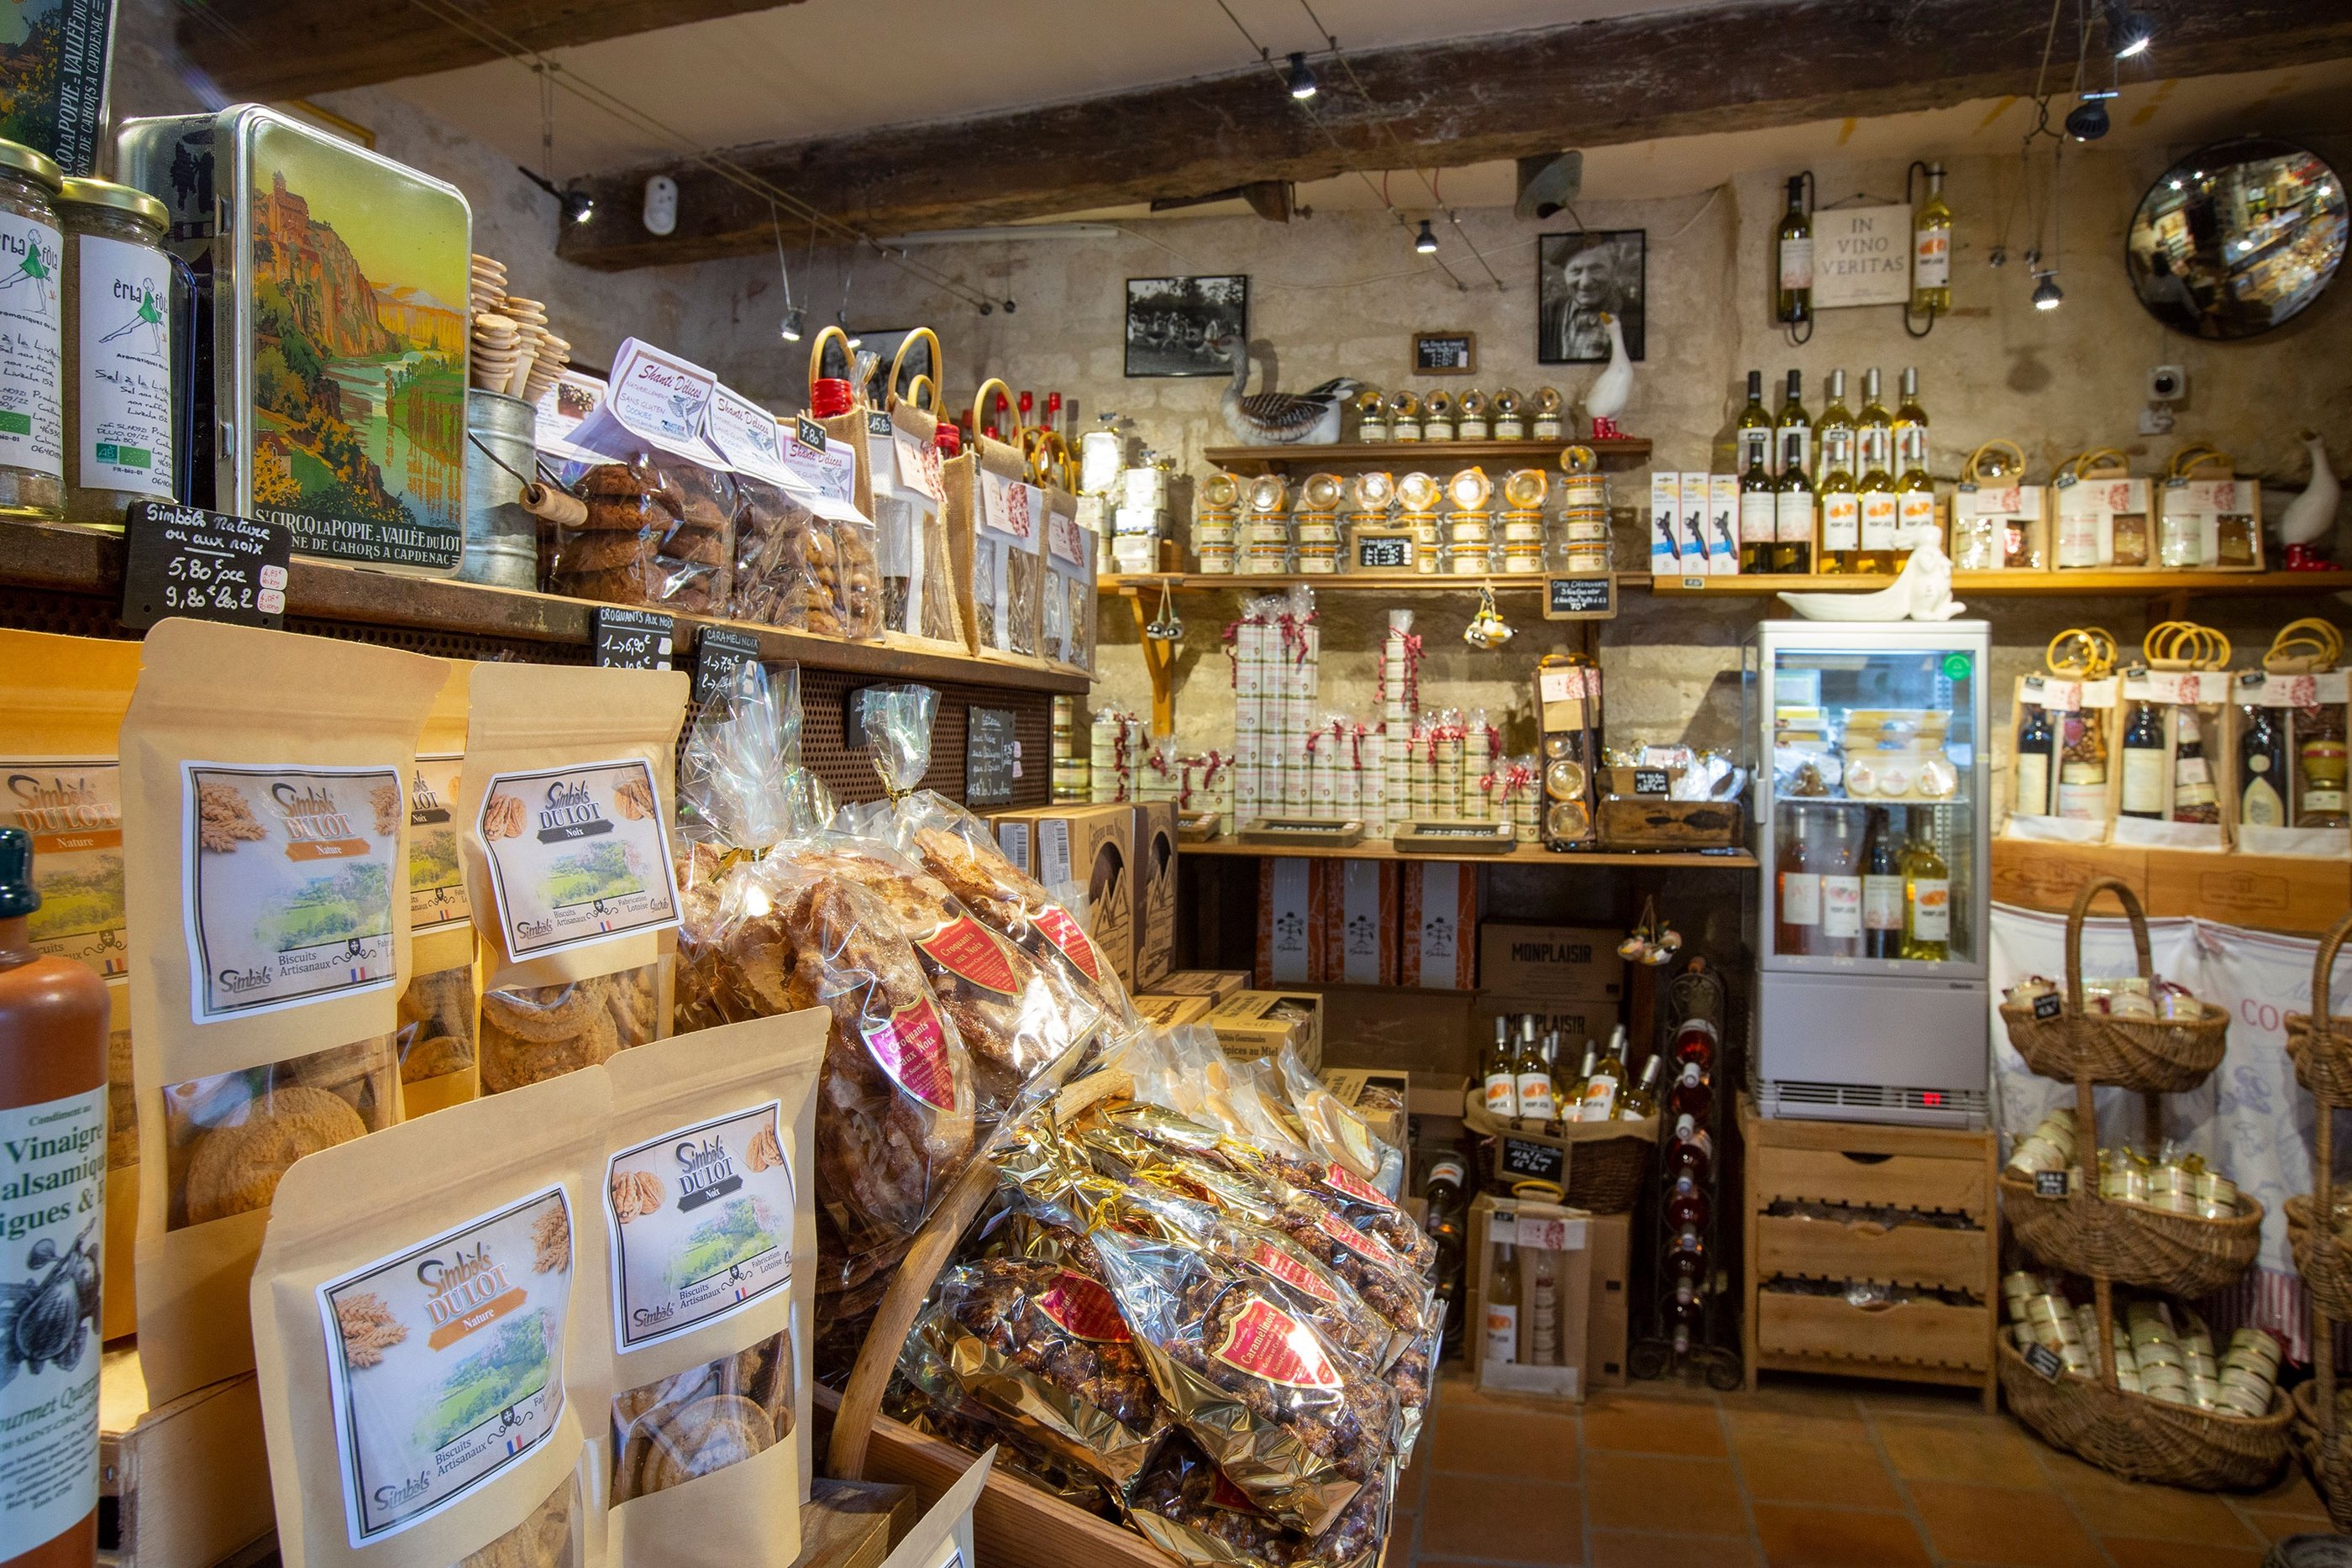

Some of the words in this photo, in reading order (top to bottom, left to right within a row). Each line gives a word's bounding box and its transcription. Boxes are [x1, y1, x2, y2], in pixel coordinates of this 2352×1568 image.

[87, 12, 105, 75] CAPDENAC
[81, 85, 99, 134] CAHORS
[1851, 217, 1872, 233] IN
[0, 233, 26, 256] rba
[1837, 237, 1888, 254] VINO
[1821, 255, 1905, 275] VERITAS
[0, 310, 43, 327] romatiques
[165, 529, 187, 542] ou
[192, 533, 225, 548] aux
[329, 519, 375, 543] POPIE
[381, 526, 427, 548] VALLÉE
[440, 534, 462, 553] LOT
[312, 538, 329, 552] DE
[332, 539, 381, 559] CAHORS
[393, 548, 450, 566] CAPDENAC
[600, 608, 643, 624] CROQUANTS
[16, 806, 62, 833] DU
[64, 803, 116, 831] LOT
[283, 817, 312, 840] DU
[312, 812, 355, 839] LOT
[538, 808, 567, 830] DU
[566, 802, 602, 825] LOT
[57, 836, 94, 849] Nature
[565, 827, 585, 838] Noix
[315, 843, 344, 856] Nature
[553, 909, 577, 919] Biscuits
[556, 914, 587, 928] Artisanaux
[940, 931, 975, 957] Croquants
[953, 952, 968, 965] aux
[964, 941, 984, 957] Noix
[1512, 943, 1593, 964] MONPLAISIR
[277, 951, 318, 967] Biscuits
[279, 960, 331, 978] Artisanaux
[887, 1020, 929, 1054] Croquants
[900, 1050, 917, 1067] aux
[915, 1035, 937, 1053] Noix
[1249, 1047, 1259, 1056] au
[1260, 1046, 1278, 1057] Miel
[4, 1123, 104, 1165] Vinaigre
[1, 1153, 106, 1202] alsamiqu
[678, 1172, 706, 1196] DU
[705, 1156, 737, 1186] LOT
[706, 1187, 721, 1202] Noix
[0, 1199, 71, 1241] igues
[77, 1188, 94, 1214] &
[751, 1250, 781, 1270] Fabrication
[759, 1258, 784, 1275] Lotoise
[423, 1287, 466, 1327] DU
[465, 1262, 511, 1308] LOT
[679, 1282, 710, 1301] Biscuits
[680, 1287, 722, 1308] Artisanaux
[463, 1307, 495, 1331] Nature
[1240, 1310, 1278, 1366] Caramélinoix
[434, 1438, 472, 1466] Biscuits
[436, 1440, 488, 1477] Artisanaux
